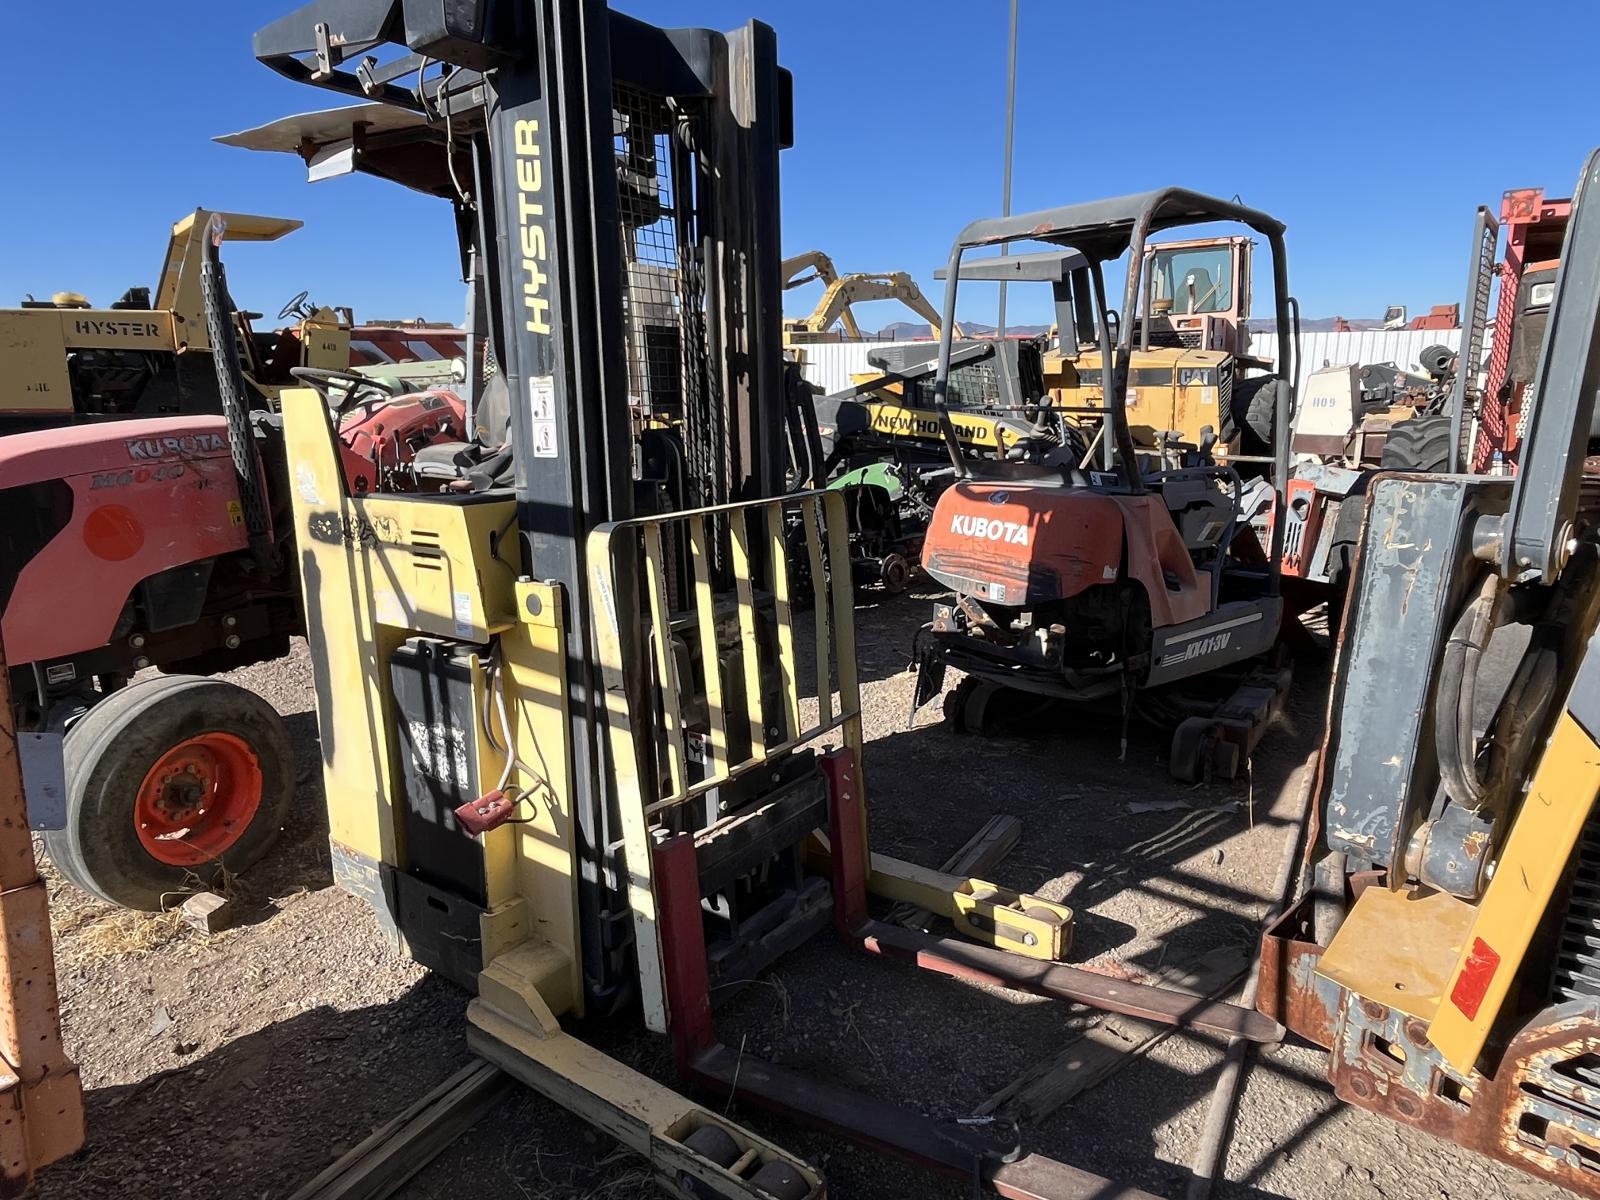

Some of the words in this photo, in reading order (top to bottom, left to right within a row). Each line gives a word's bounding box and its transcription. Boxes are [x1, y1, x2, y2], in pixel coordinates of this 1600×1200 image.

[514, 119, 551, 335] HYSTER
[75, 320, 160, 337] HYSTER
[1180, 368, 1212, 386] CAT
[916, 419, 988, 440] HOAND
[125, 433, 228, 461] KUBOTA
[950, 514, 1029, 547] KUBOTA
